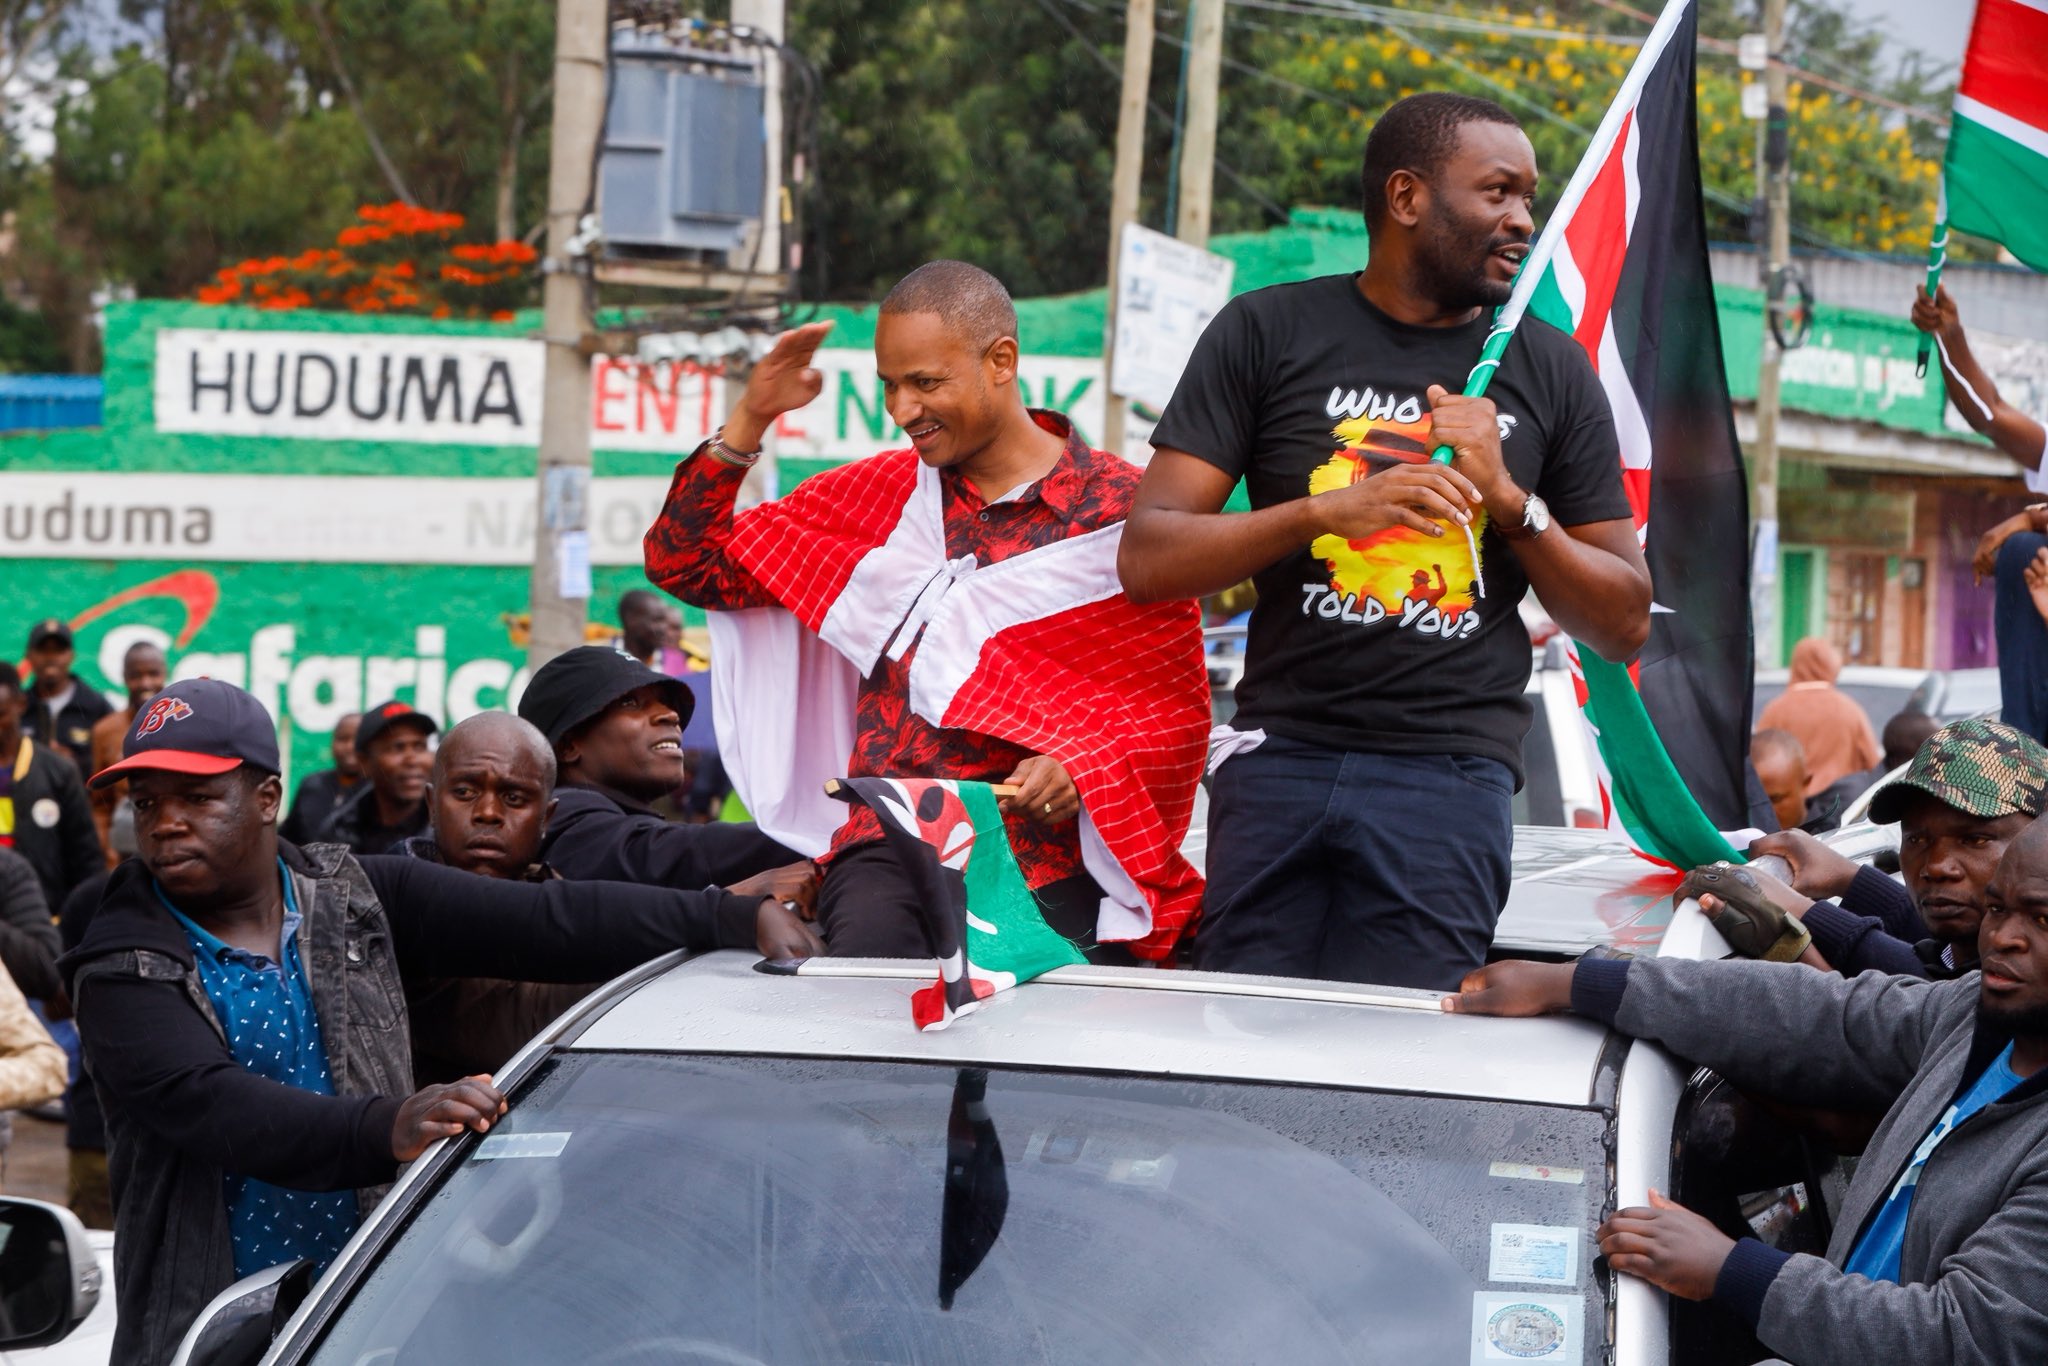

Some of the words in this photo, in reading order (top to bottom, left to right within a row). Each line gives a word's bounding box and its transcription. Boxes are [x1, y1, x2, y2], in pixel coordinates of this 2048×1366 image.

[191, 351, 523, 427] HUDUMA
[1325, 385, 1424, 424] WHO
[1302, 583, 1386, 626] TOLD
[1398, 596, 1481, 639] YOU?
